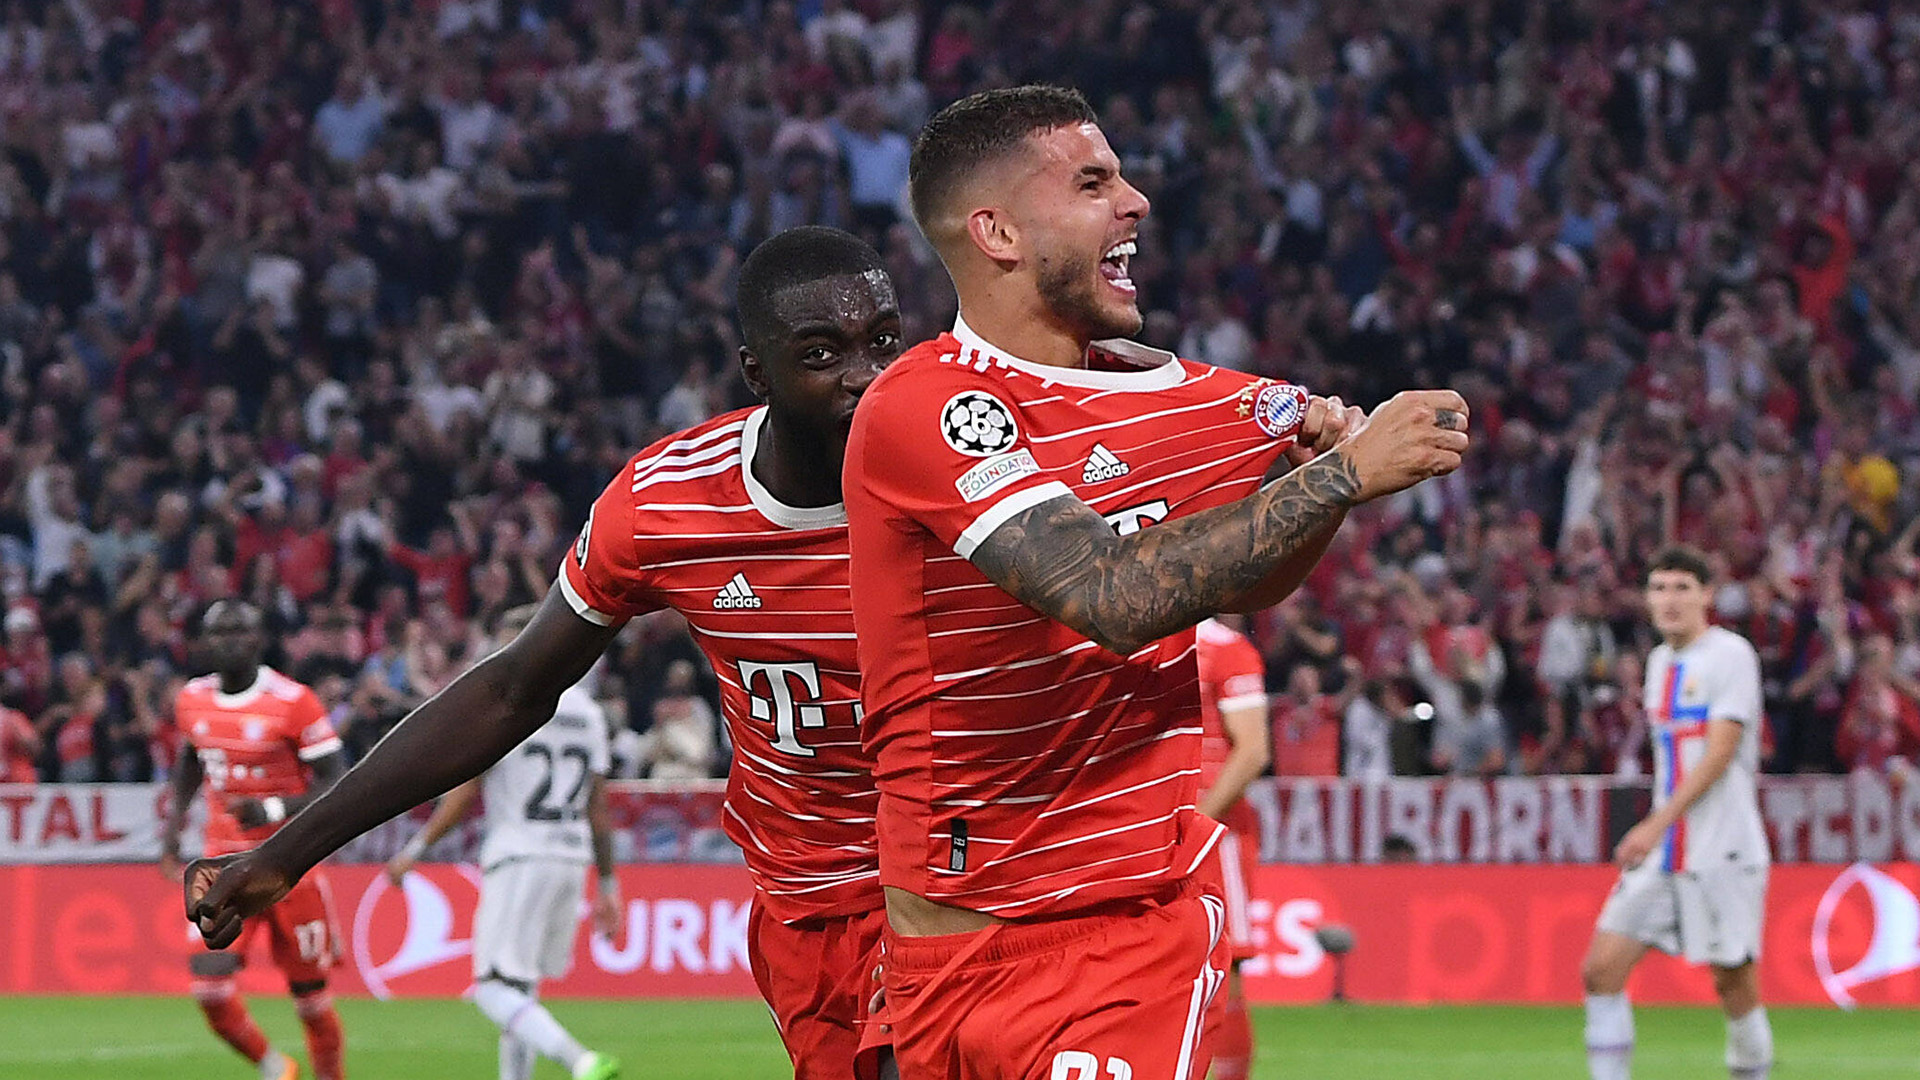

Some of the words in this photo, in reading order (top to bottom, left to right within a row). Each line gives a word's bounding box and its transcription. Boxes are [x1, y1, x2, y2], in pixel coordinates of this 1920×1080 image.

[1082, 462, 1130, 484] adidas
[713, 596, 762, 609] adidas
[736, 660, 821, 756] T
[524, 742, 590, 821] 22
[1, 795, 128, 842] TAL
[579, 899, 752, 975] URK
